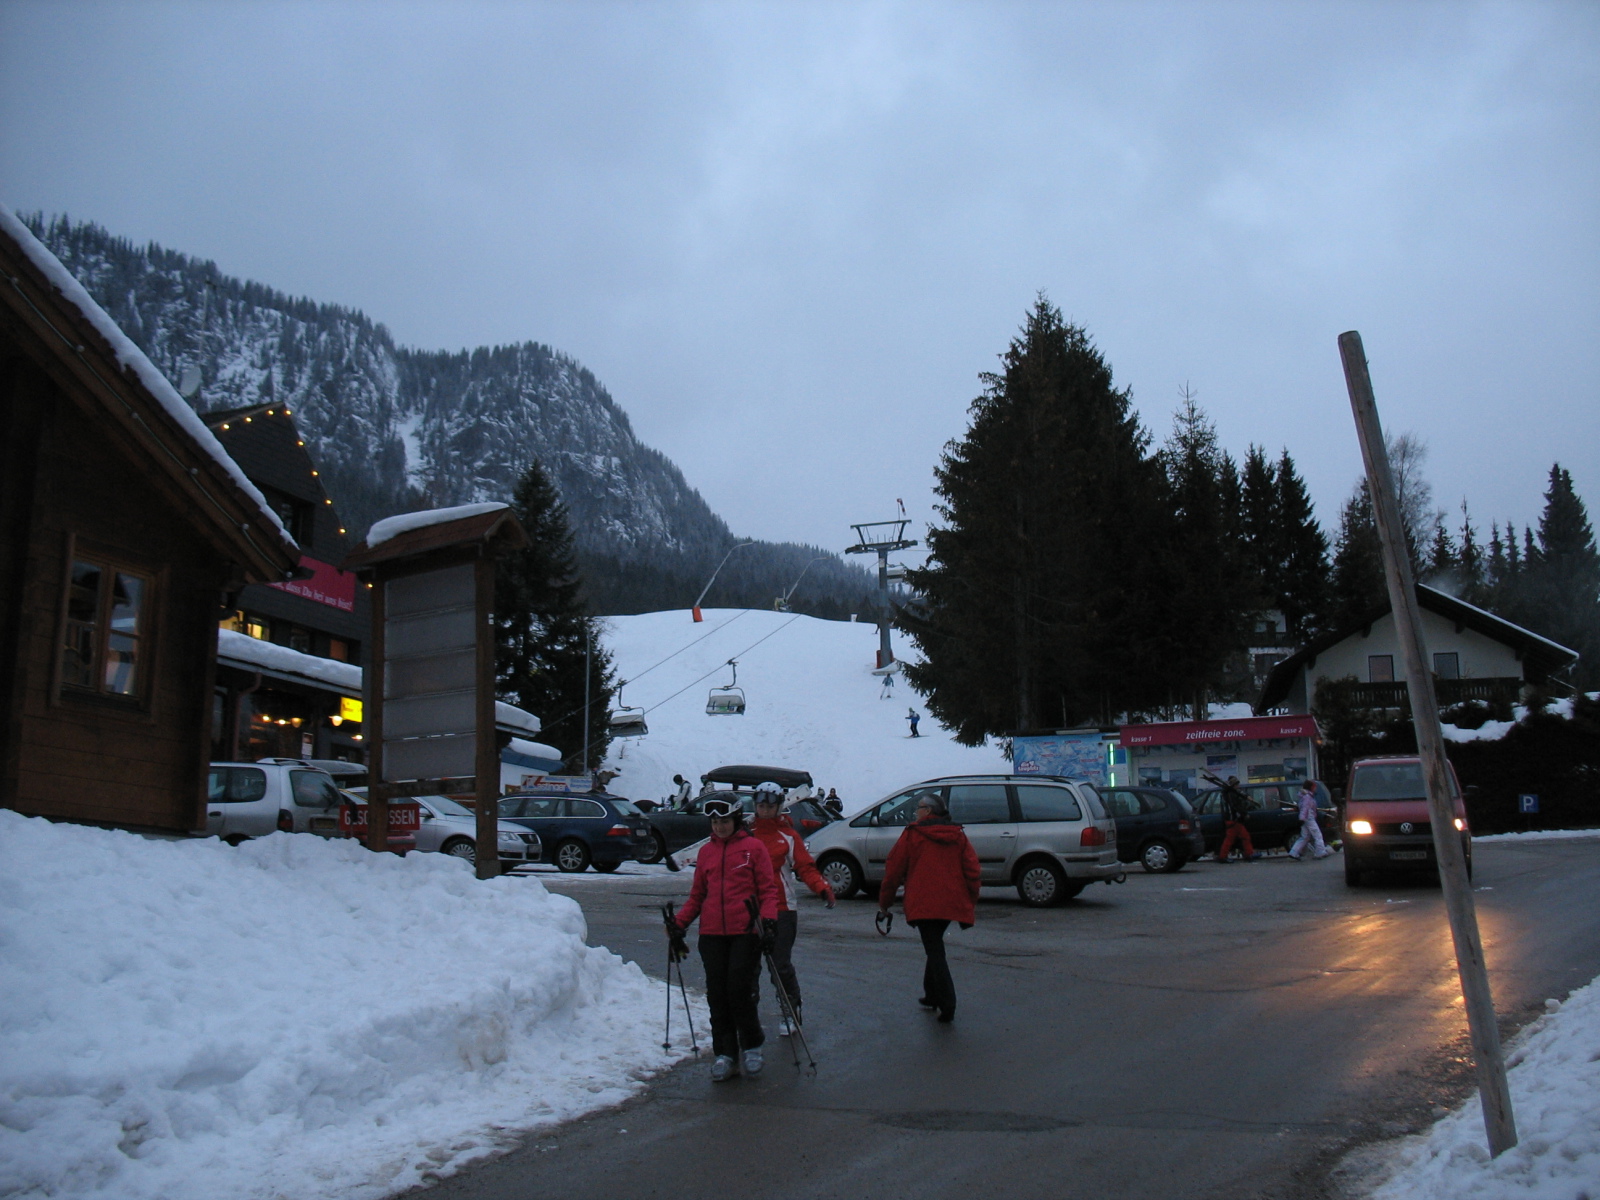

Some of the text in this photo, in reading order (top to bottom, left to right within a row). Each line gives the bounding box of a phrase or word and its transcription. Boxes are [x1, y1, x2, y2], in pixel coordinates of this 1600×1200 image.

[303, 586, 313, 598] Du
[1185, 729, 1247, 740] zeitfreie zone.
[1523, 795, 1534, 811] P
